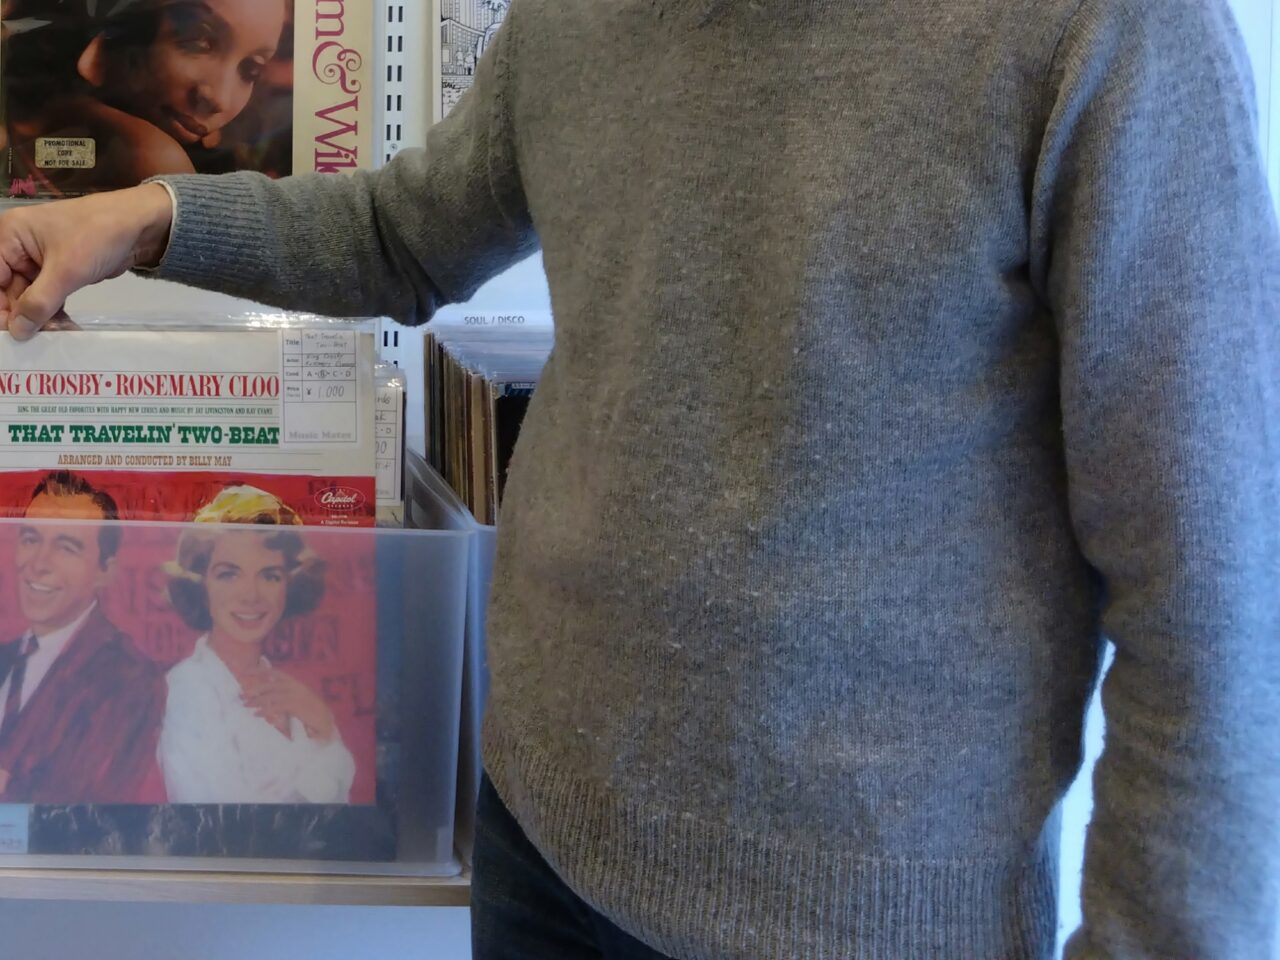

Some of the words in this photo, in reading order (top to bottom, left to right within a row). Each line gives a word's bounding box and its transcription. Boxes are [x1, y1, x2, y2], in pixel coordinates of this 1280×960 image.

[44, 139, 86, 147] PROMOTIONAL
[57, 149, 73, 157] COPY
[464, 316, 488, 325] SOUL
[497, 315, 525, 324] DISCO
[25, 372, 103, 396] CROSBY
[115, 373, 224, 397] ROSEMARY
[228, 374, 280, 398] CLOO
[30, 406, 40, 414] THE
[41, 406, 57, 414] GREAT
[58, 406, 68, 414] OLD
[69, 406, 95, 414] FAVORITES
[96, 406, 110, 414] WITH
[110, 406, 127, 414] HAPPY
[128, 406, 140, 414] NEW
[187, 407, 194, 415] BY
[205, 407, 234, 415] LIVINGSTON
[235, 407, 245, 415] AND
[8, 424, 65, 443] THAT
[69, 422, 176, 443] TRAVELIN'
[177, 425, 280, 445] TWO-BEAT
[57, 454, 103, 466] ARRANGED
[104, 454, 123, 466] AND
[124, 455, 174, 466] CONDUCTED
[176, 455, 188, 466] BY
[189, 456, 213, 467] BILLY
[213, 456, 233, 467] MAY
[320, 491, 358, 505] Capitol
